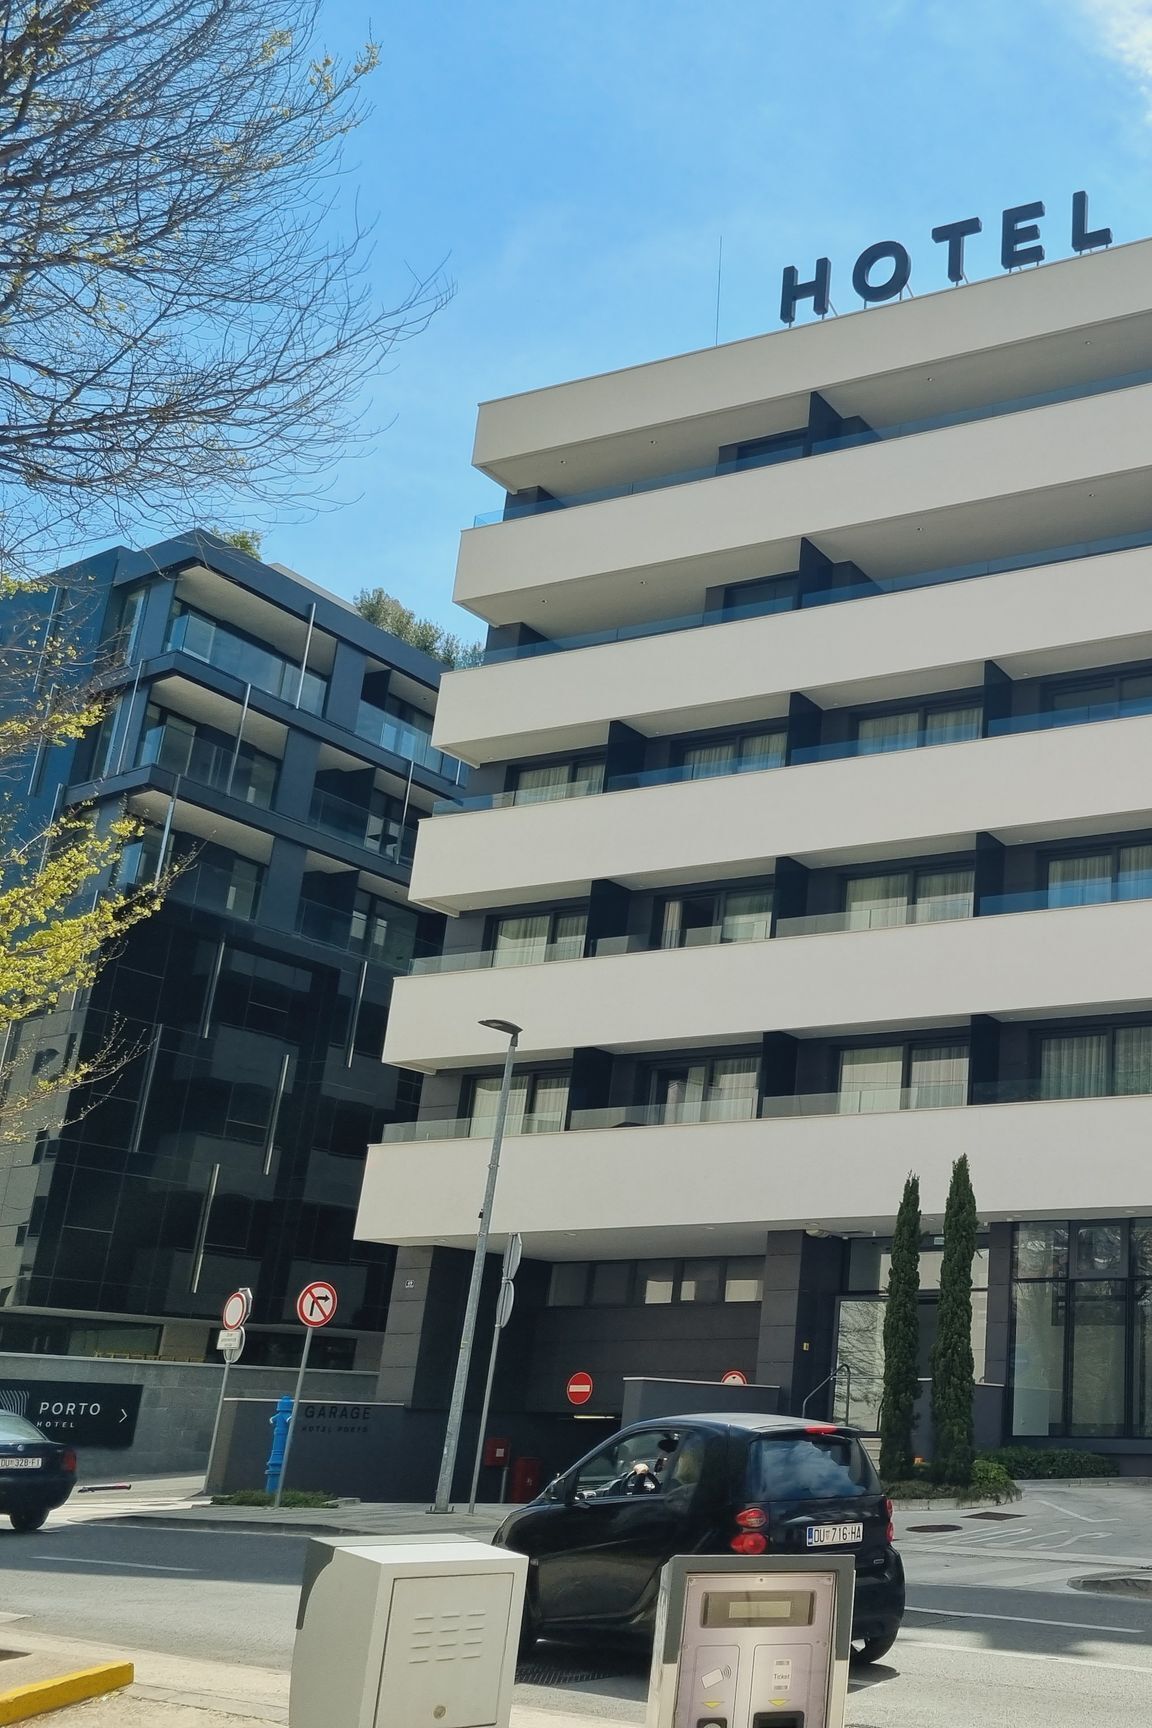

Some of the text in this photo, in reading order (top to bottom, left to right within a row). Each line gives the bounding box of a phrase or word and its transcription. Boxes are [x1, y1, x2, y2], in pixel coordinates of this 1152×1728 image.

[780, 191, 1113, 324] HOTEL
[40, 1402, 101, 1415] PORTO
[304, 1405, 371, 1420] GARAGE
[814, 1529, 825, 1543] DU
